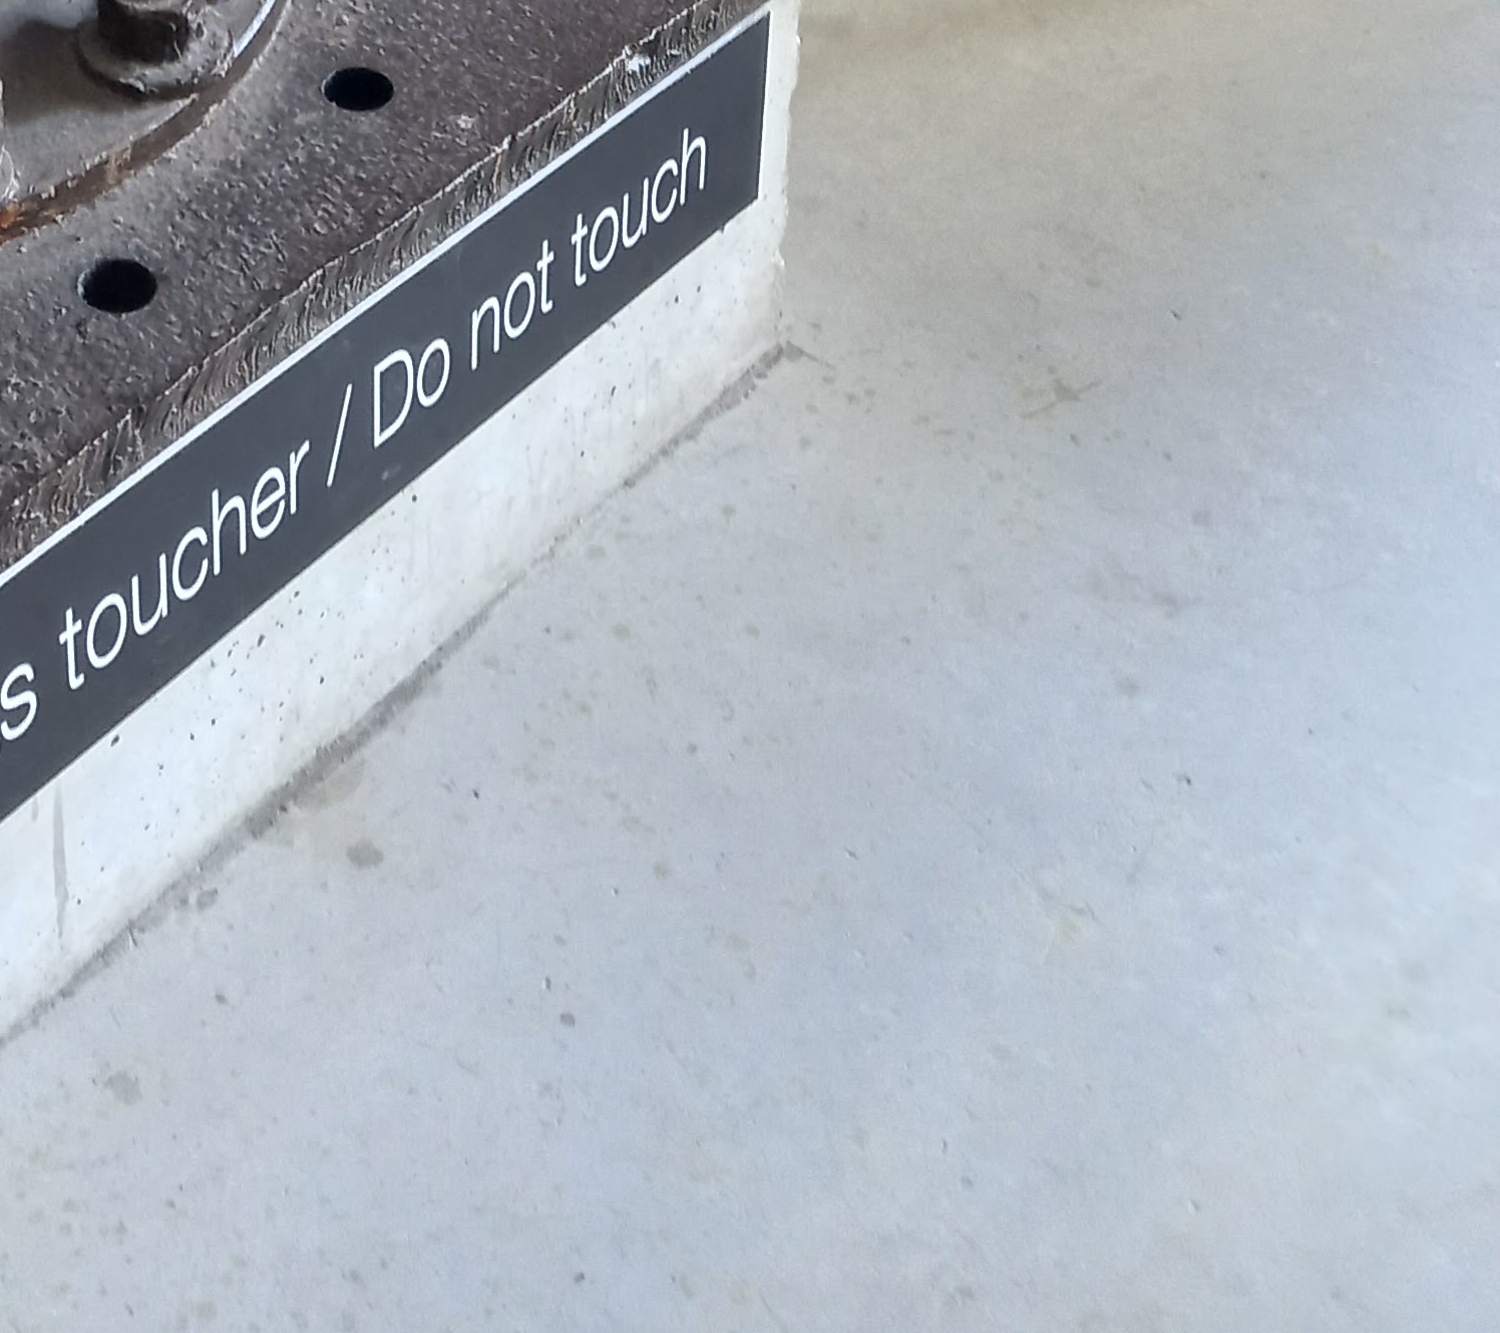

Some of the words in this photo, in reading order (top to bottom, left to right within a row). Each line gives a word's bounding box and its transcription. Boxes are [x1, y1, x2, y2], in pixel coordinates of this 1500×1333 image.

[59, 440, 310, 689] toucher
[327, 384, 352, 487] /
[374, 338, 451, 448] Do
[472, 240, 555, 370] not
[571, 128, 707, 286] touch
